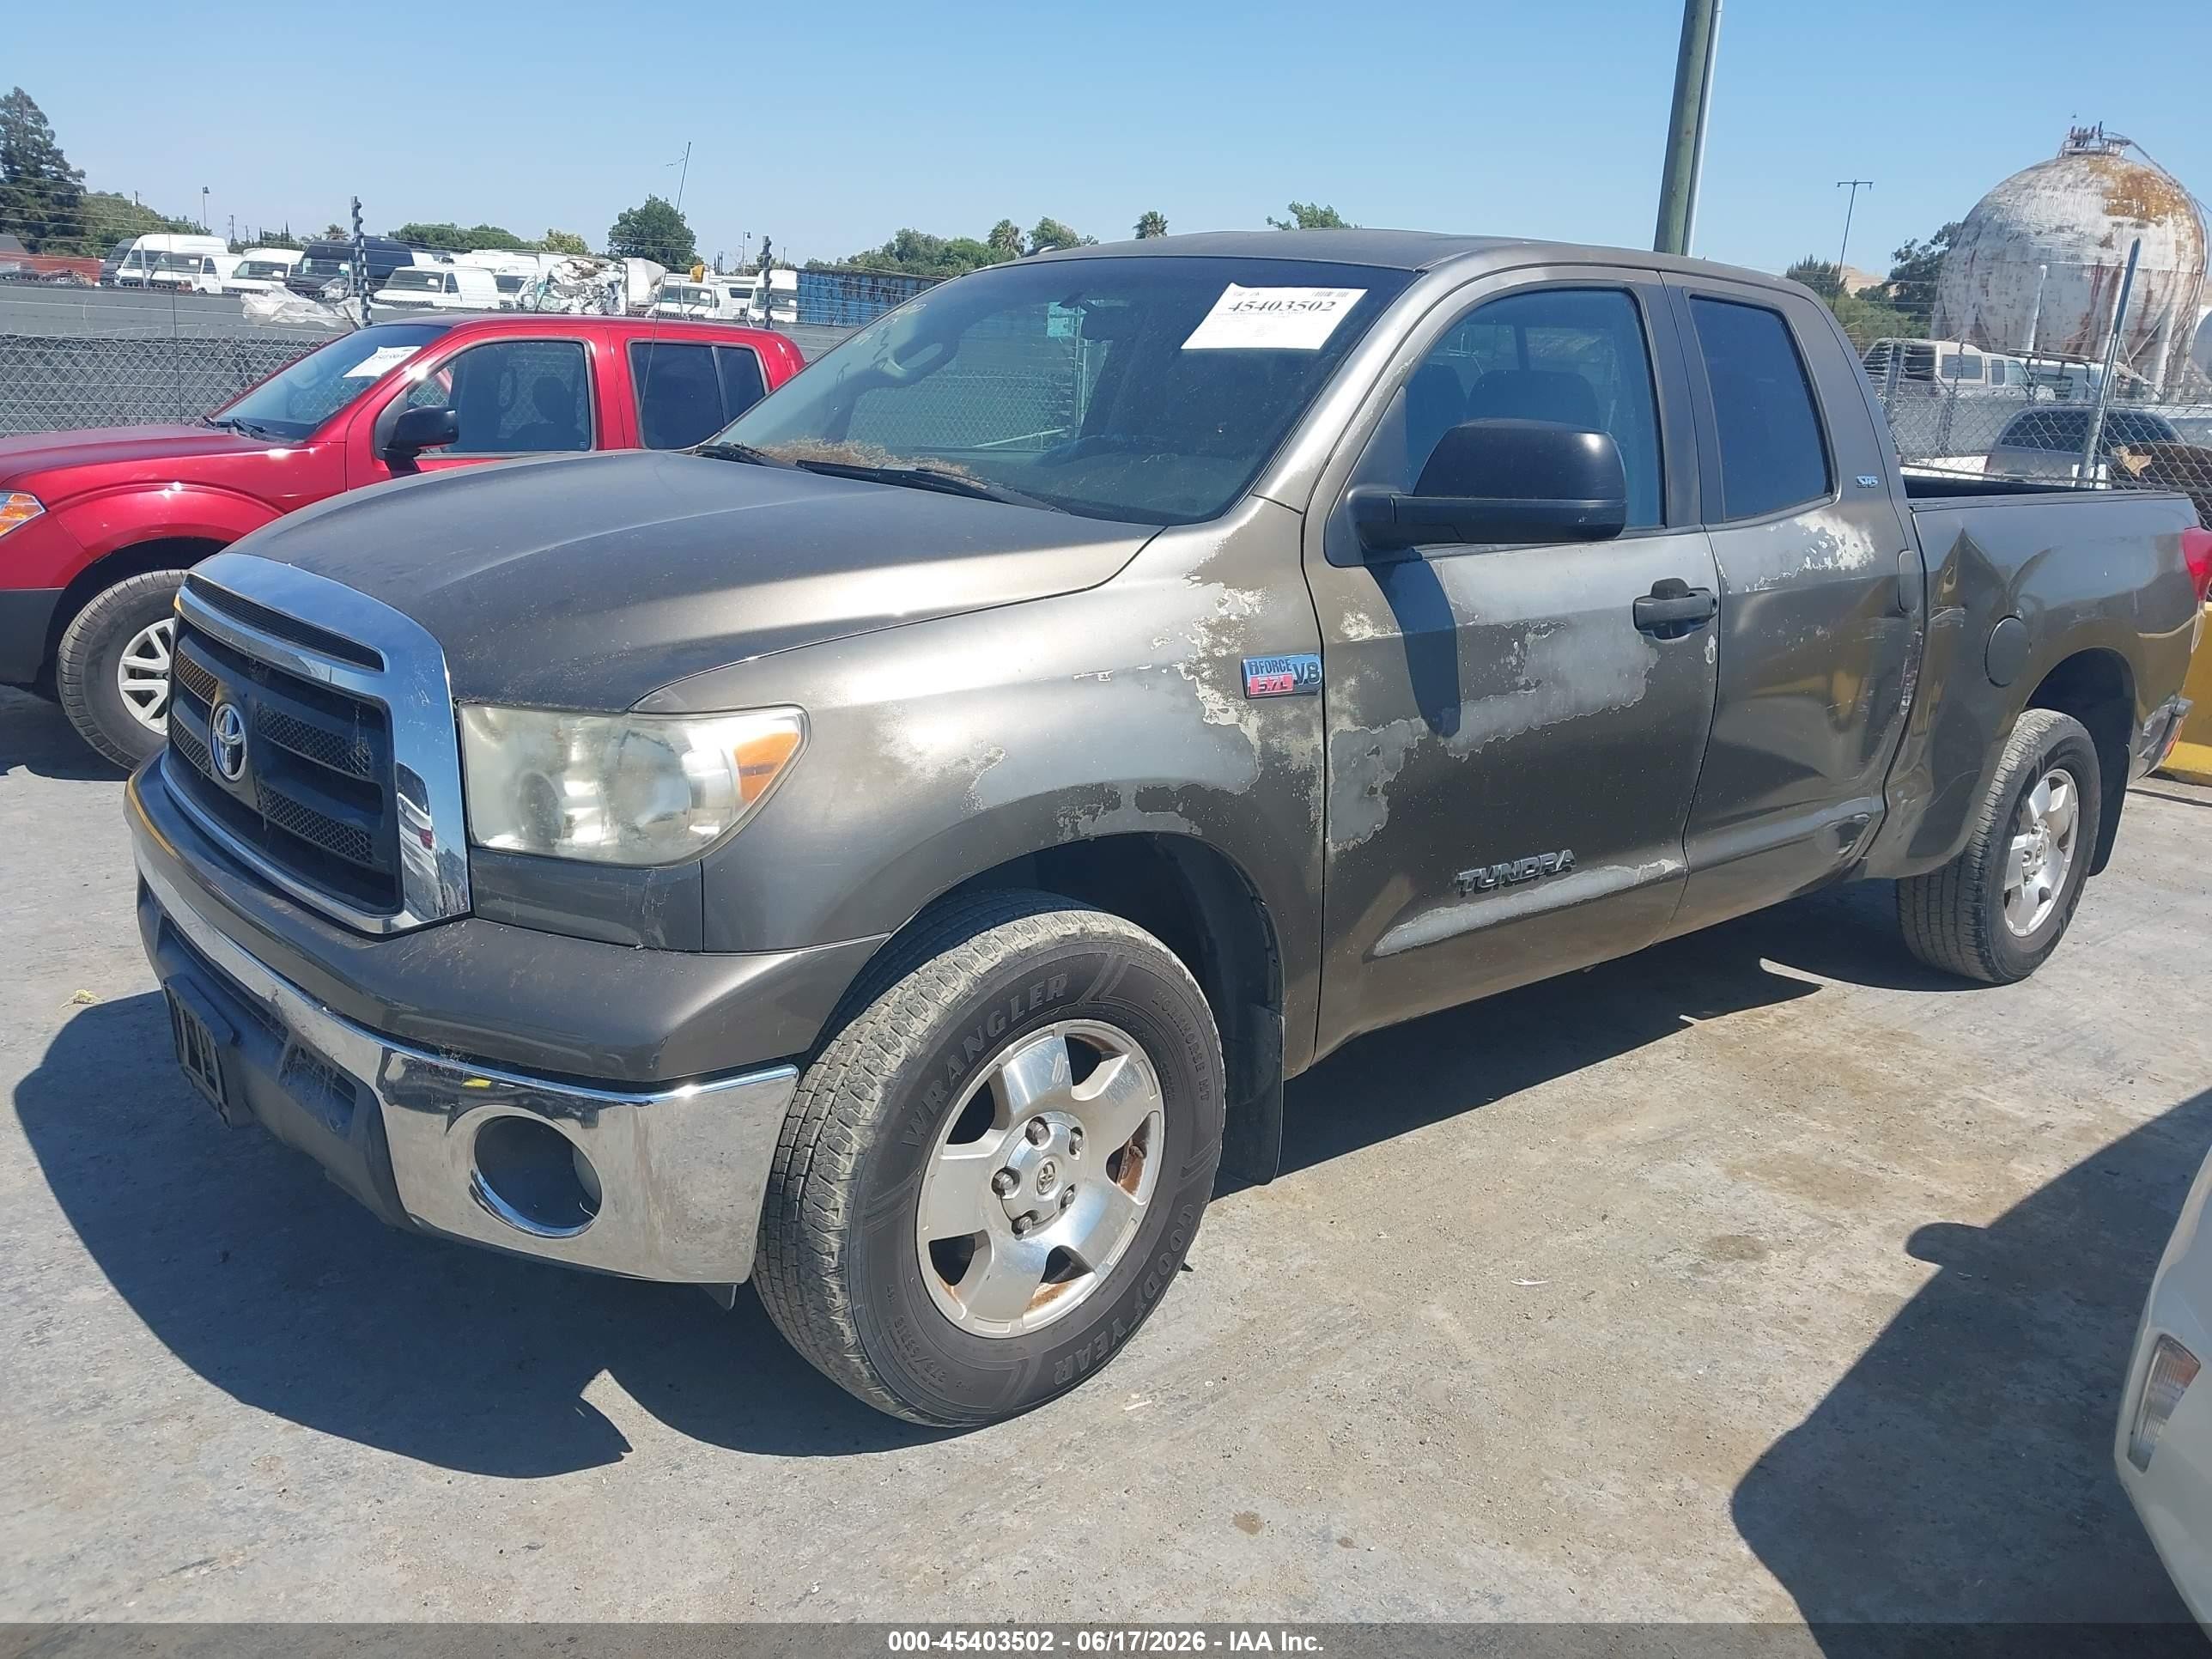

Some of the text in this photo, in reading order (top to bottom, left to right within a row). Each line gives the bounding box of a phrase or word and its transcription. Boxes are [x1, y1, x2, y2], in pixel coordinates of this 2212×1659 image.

[1228, 300, 1337, 313] 45403502
[1257, 675, 1289, 693] 5.7L
[1292, 661, 1322, 685] V8
[1455, 848, 1577, 896] TUNDRA
[901, 974, 1069, 1147] WRANGLER
